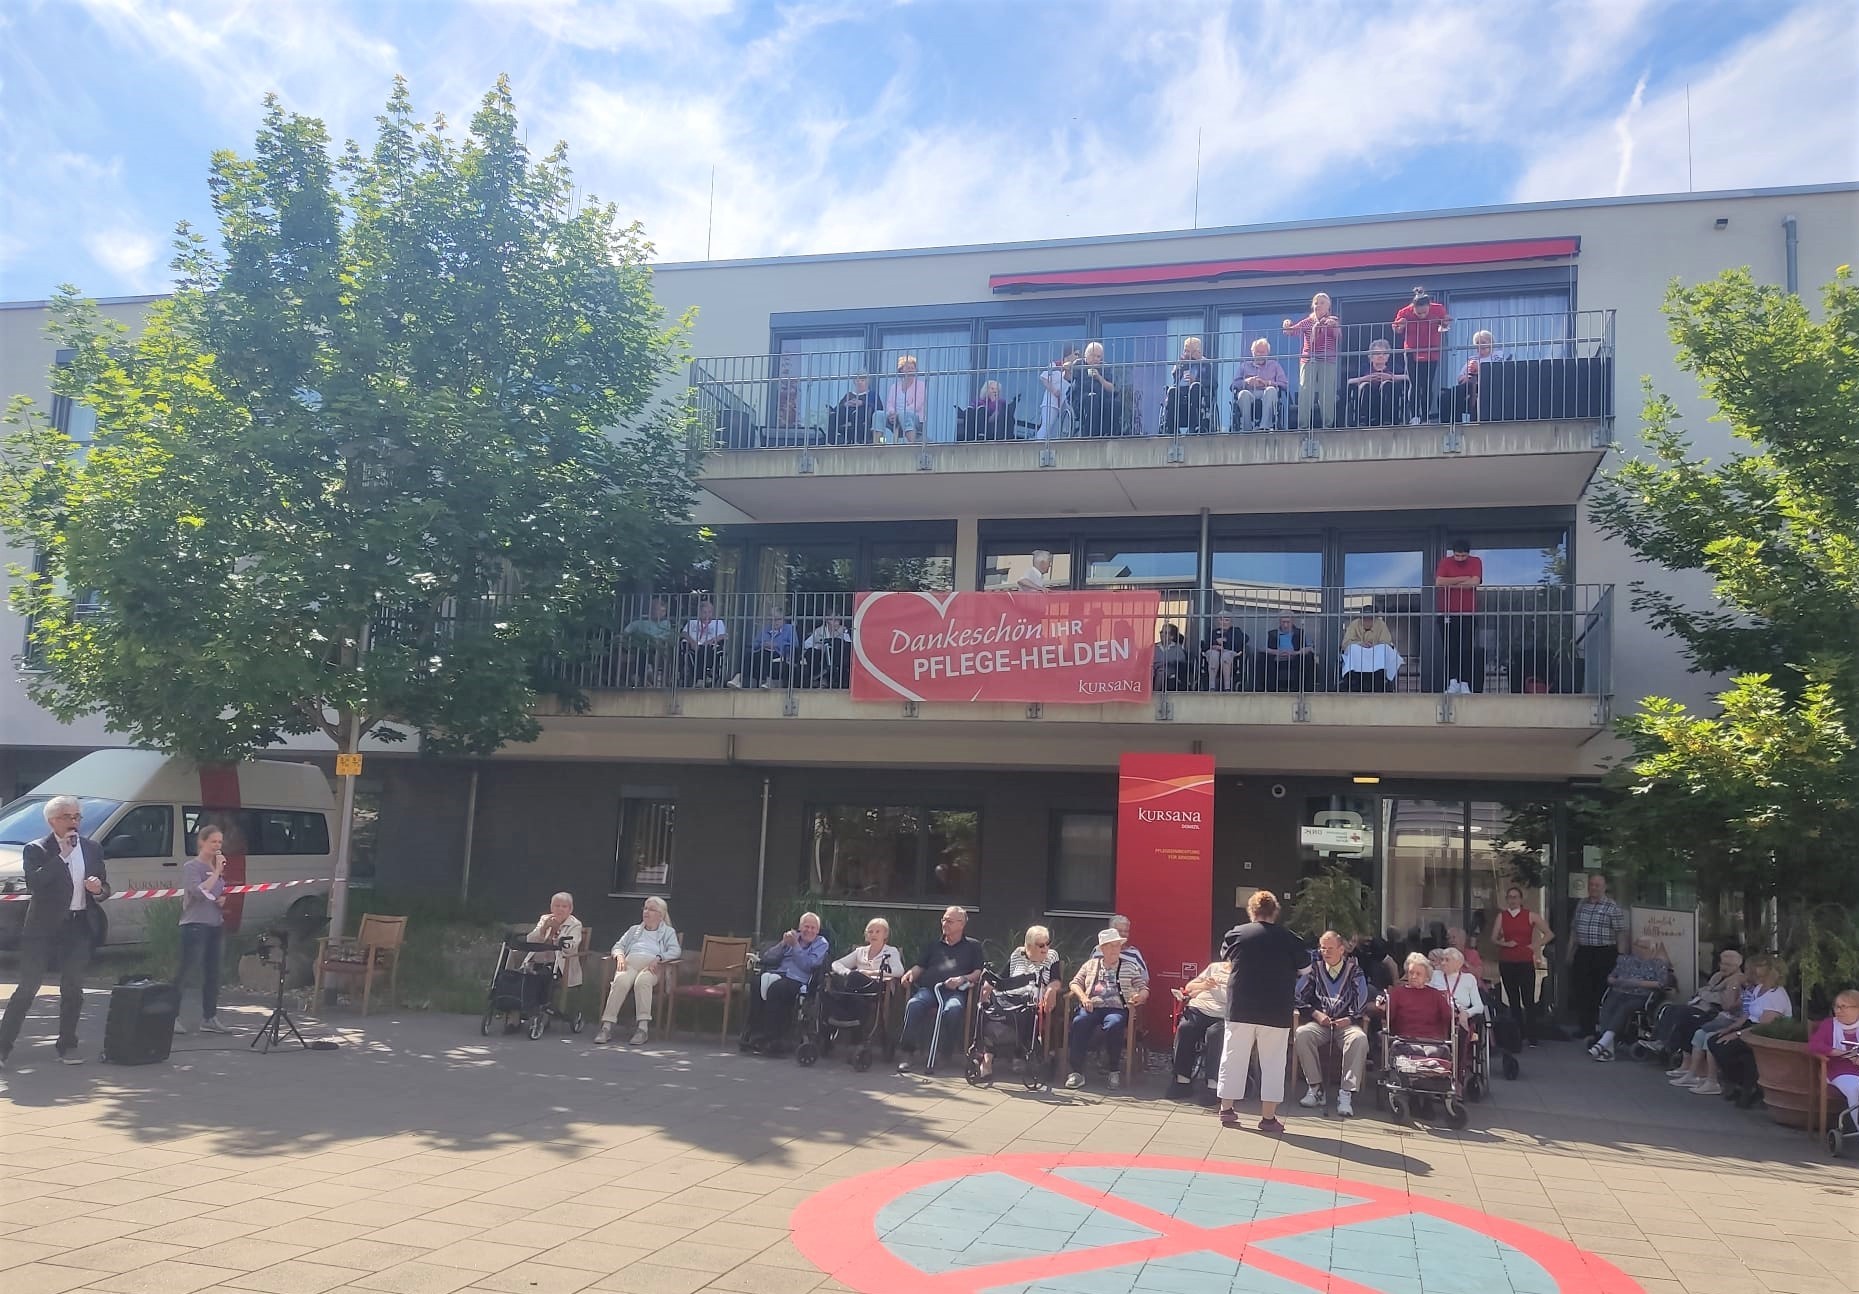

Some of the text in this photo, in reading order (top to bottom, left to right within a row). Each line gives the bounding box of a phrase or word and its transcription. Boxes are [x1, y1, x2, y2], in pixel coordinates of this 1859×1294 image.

[890, 613, 1083, 654] Dankeschön IHR
[913, 638, 1129, 680] PFLEGE-HELDEN
